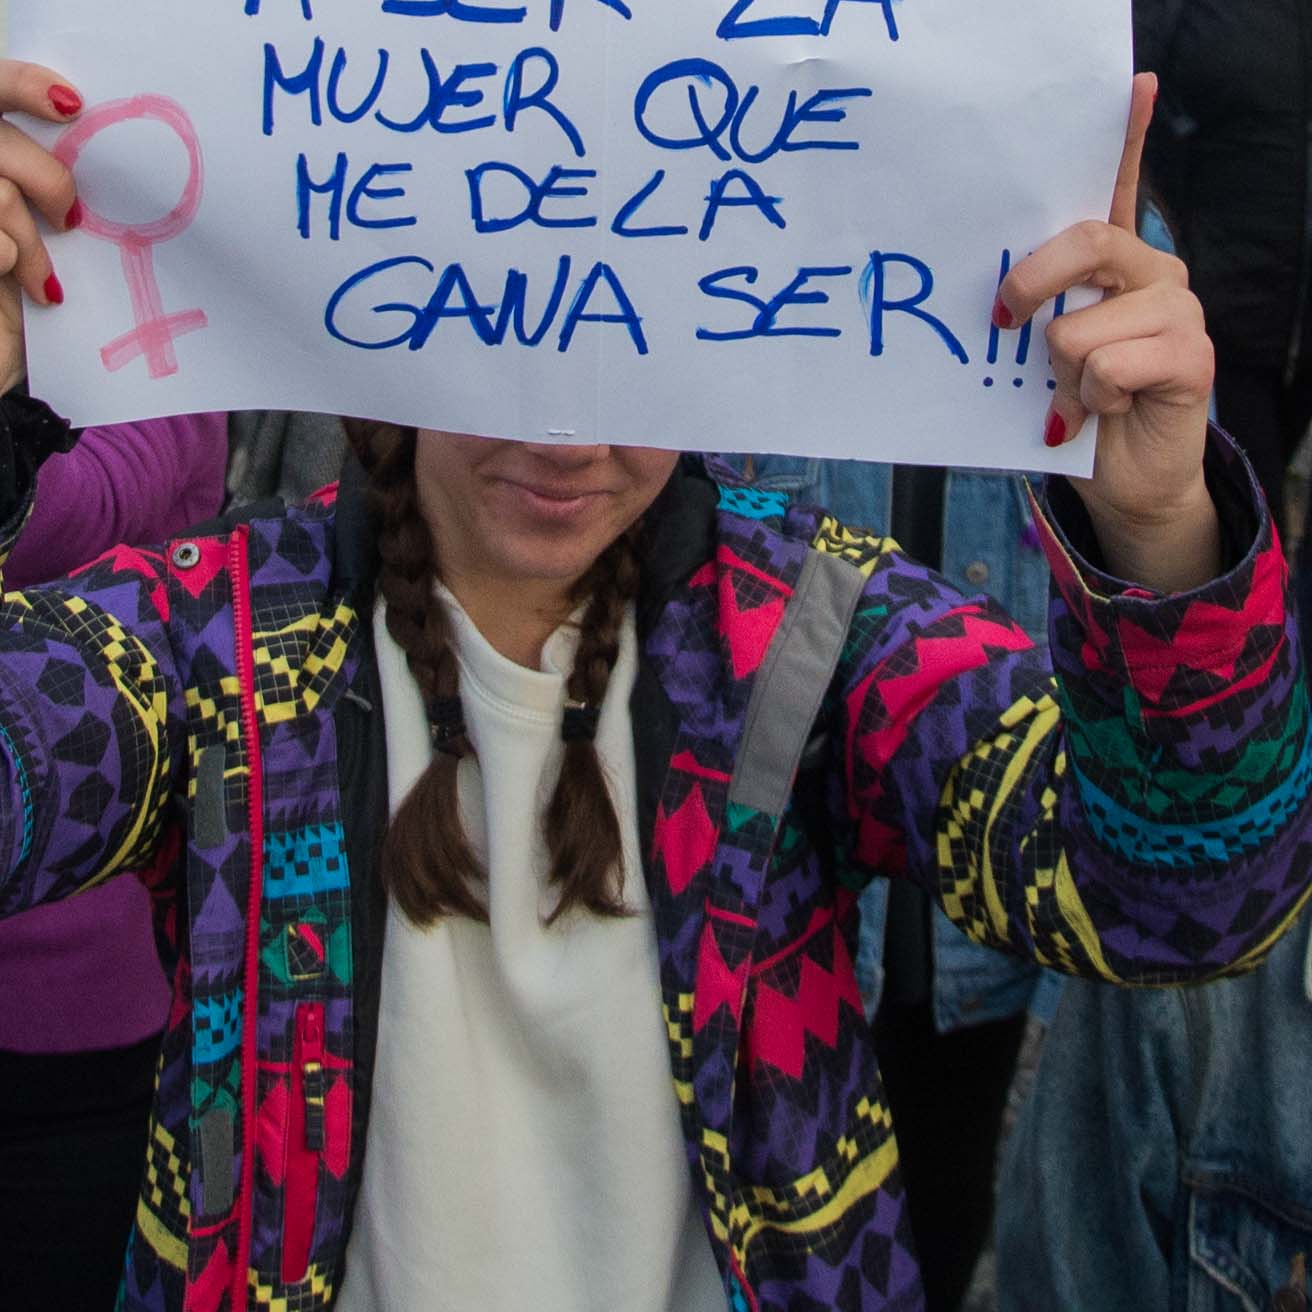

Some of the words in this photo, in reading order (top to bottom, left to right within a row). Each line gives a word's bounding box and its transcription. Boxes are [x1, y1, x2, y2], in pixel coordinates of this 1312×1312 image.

[262, 37, 586, 159] MUJER
[633, 57, 873, 165] QUE
[294, 152, 419, 241] ME
[324, 254, 649, 356] GANA
